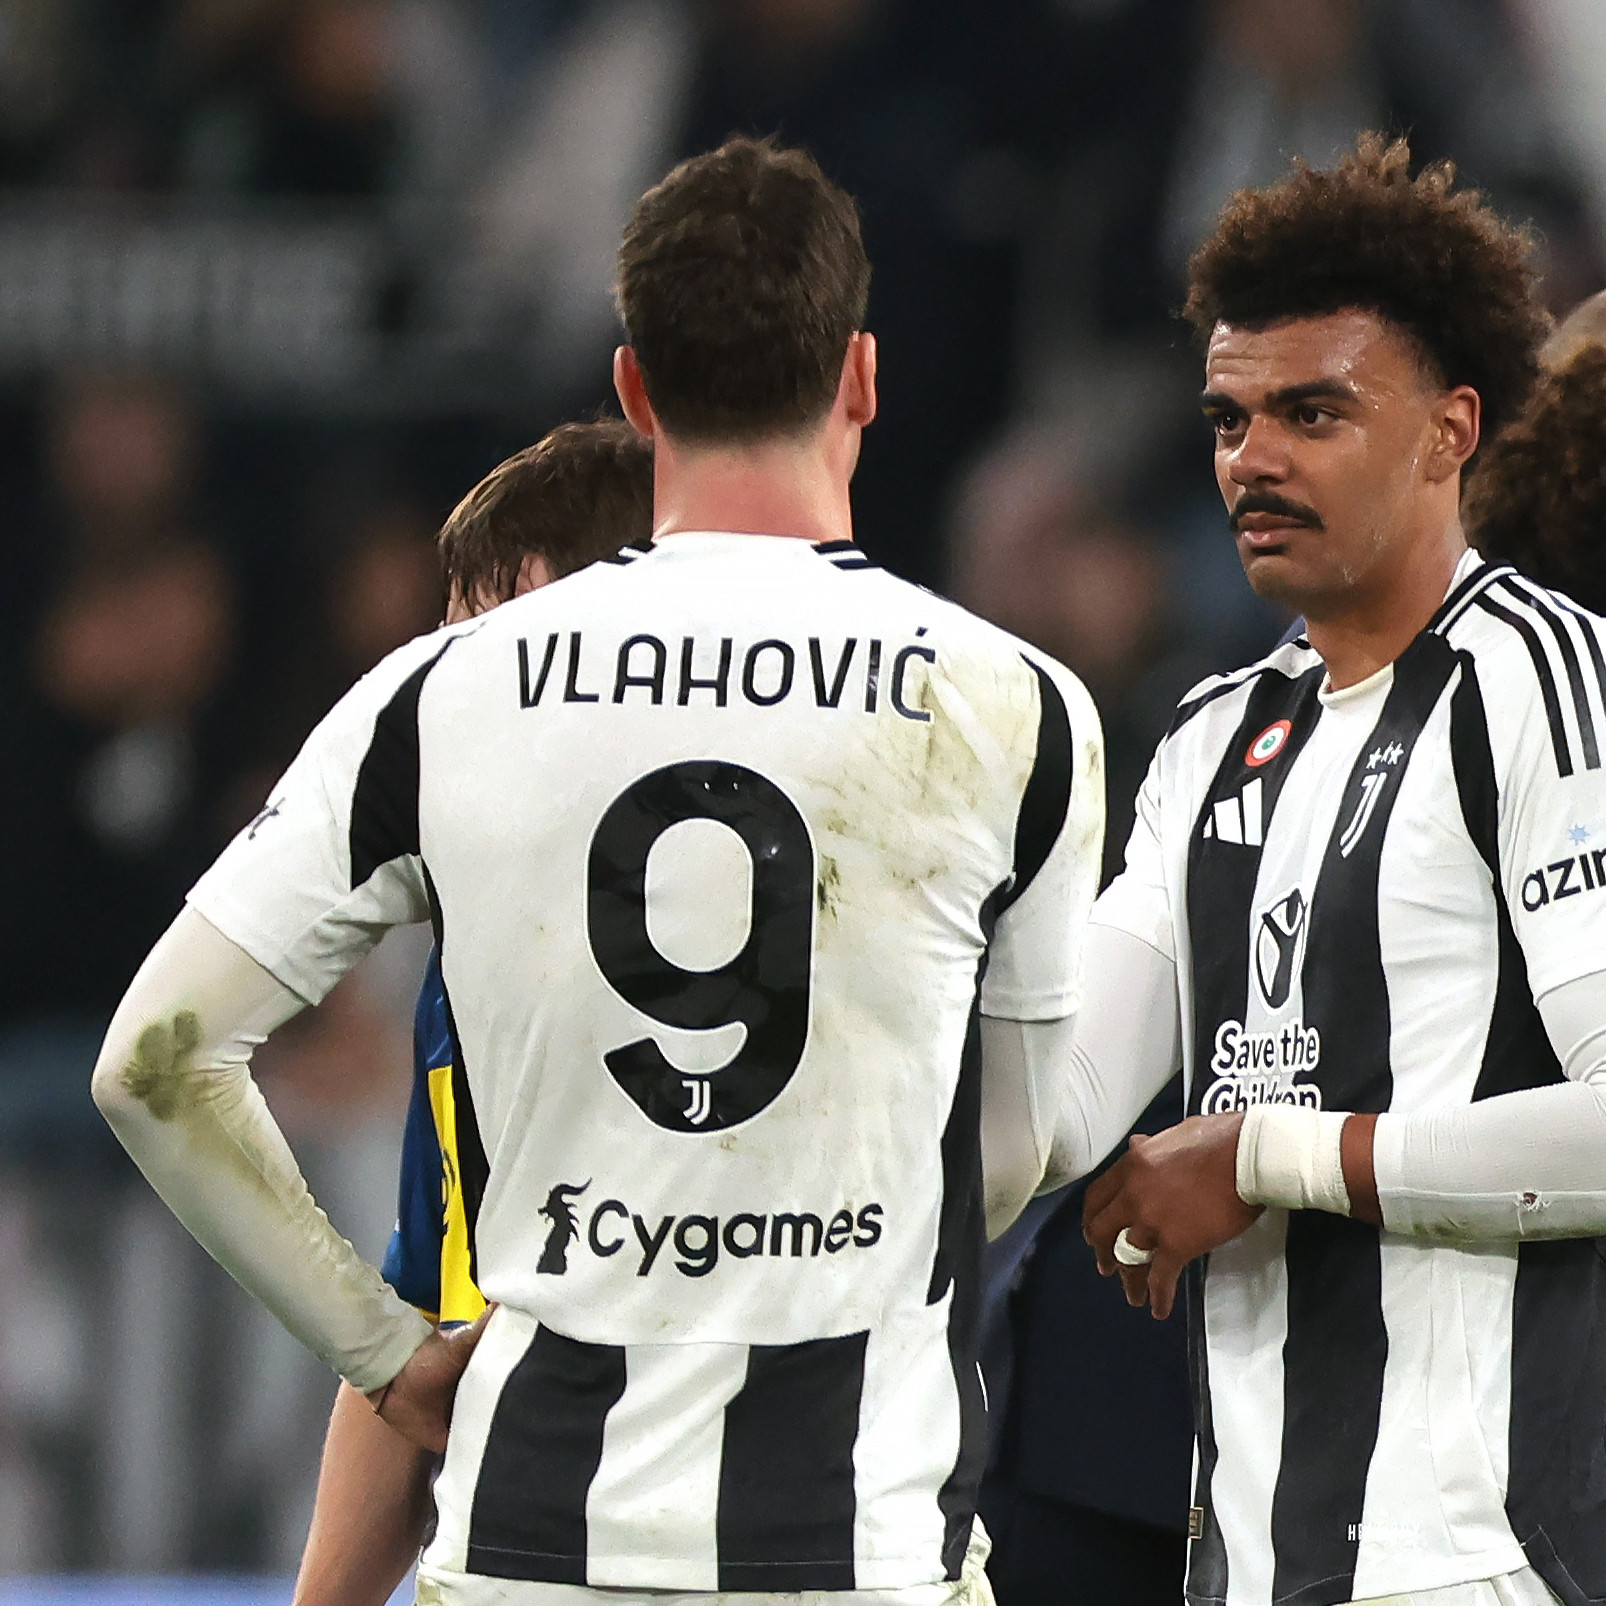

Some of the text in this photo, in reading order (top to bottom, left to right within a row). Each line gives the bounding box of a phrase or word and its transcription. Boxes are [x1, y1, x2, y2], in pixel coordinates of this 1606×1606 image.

[516, 625, 937, 722] VLAHOVIĆ
[587, 759, 815, 1133] 9
[1216, 1023, 1318, 1071] Save the
[587, 1199, 885, 1278] Cygames
